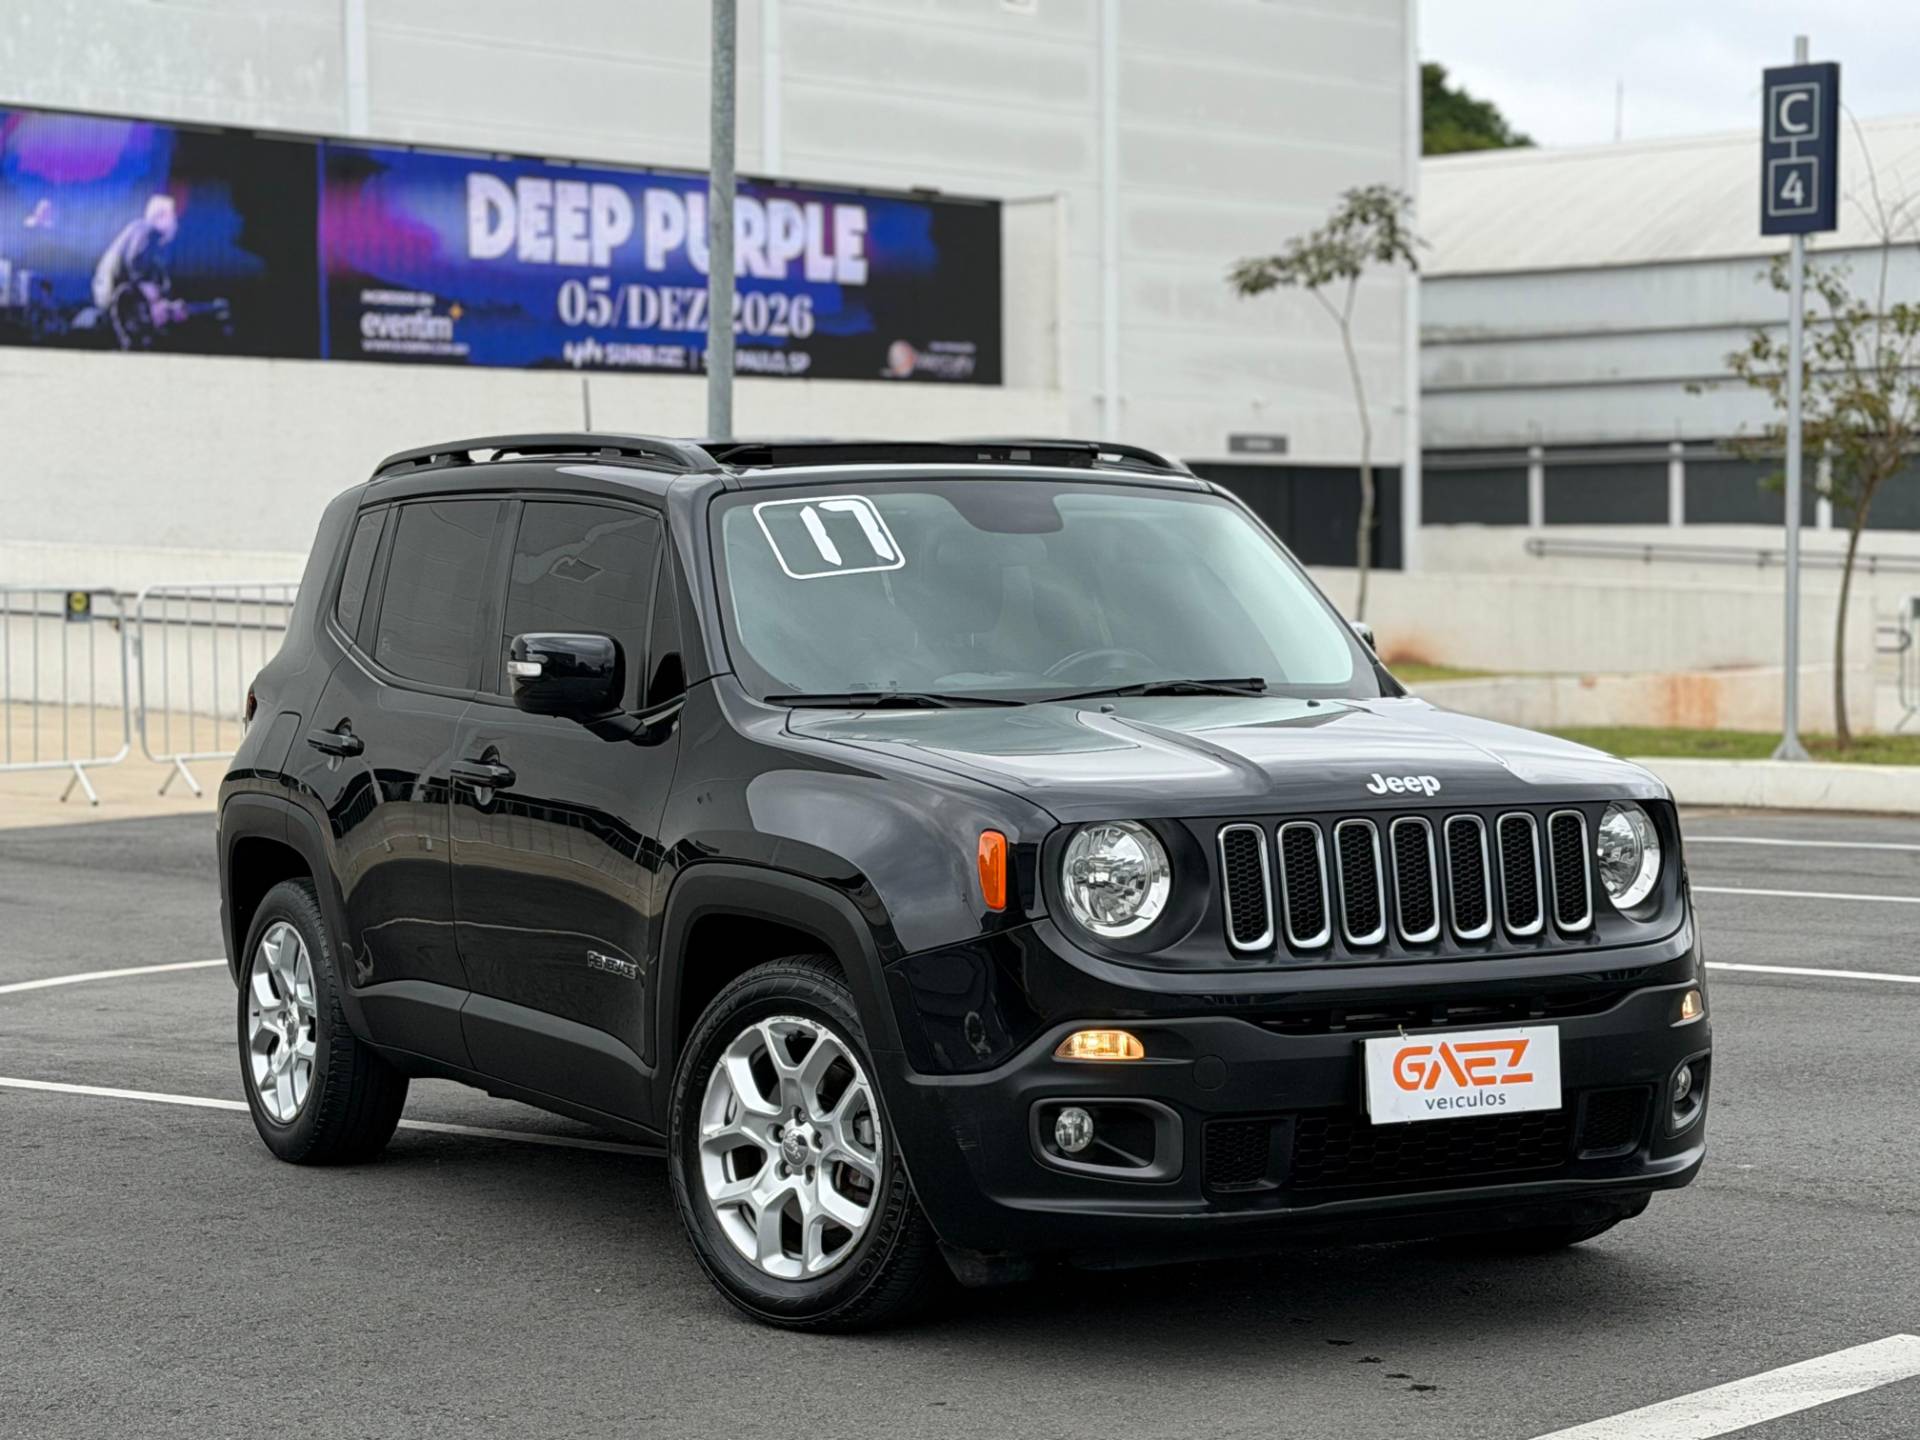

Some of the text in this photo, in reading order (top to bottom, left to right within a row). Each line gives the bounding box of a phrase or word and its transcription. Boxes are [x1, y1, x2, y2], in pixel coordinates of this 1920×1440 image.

[1780, 92, 1809, 133] C
[1780, 170, 1804, 206] 4
[466, 172, 634, 268] DEEP
[361, 308, 453, 340] eventim
[800, 500, 895, 566] 17
[1366, 773, 1441, 796] Jeep
[1392, 1038, 1534, 1091] GAEZ
